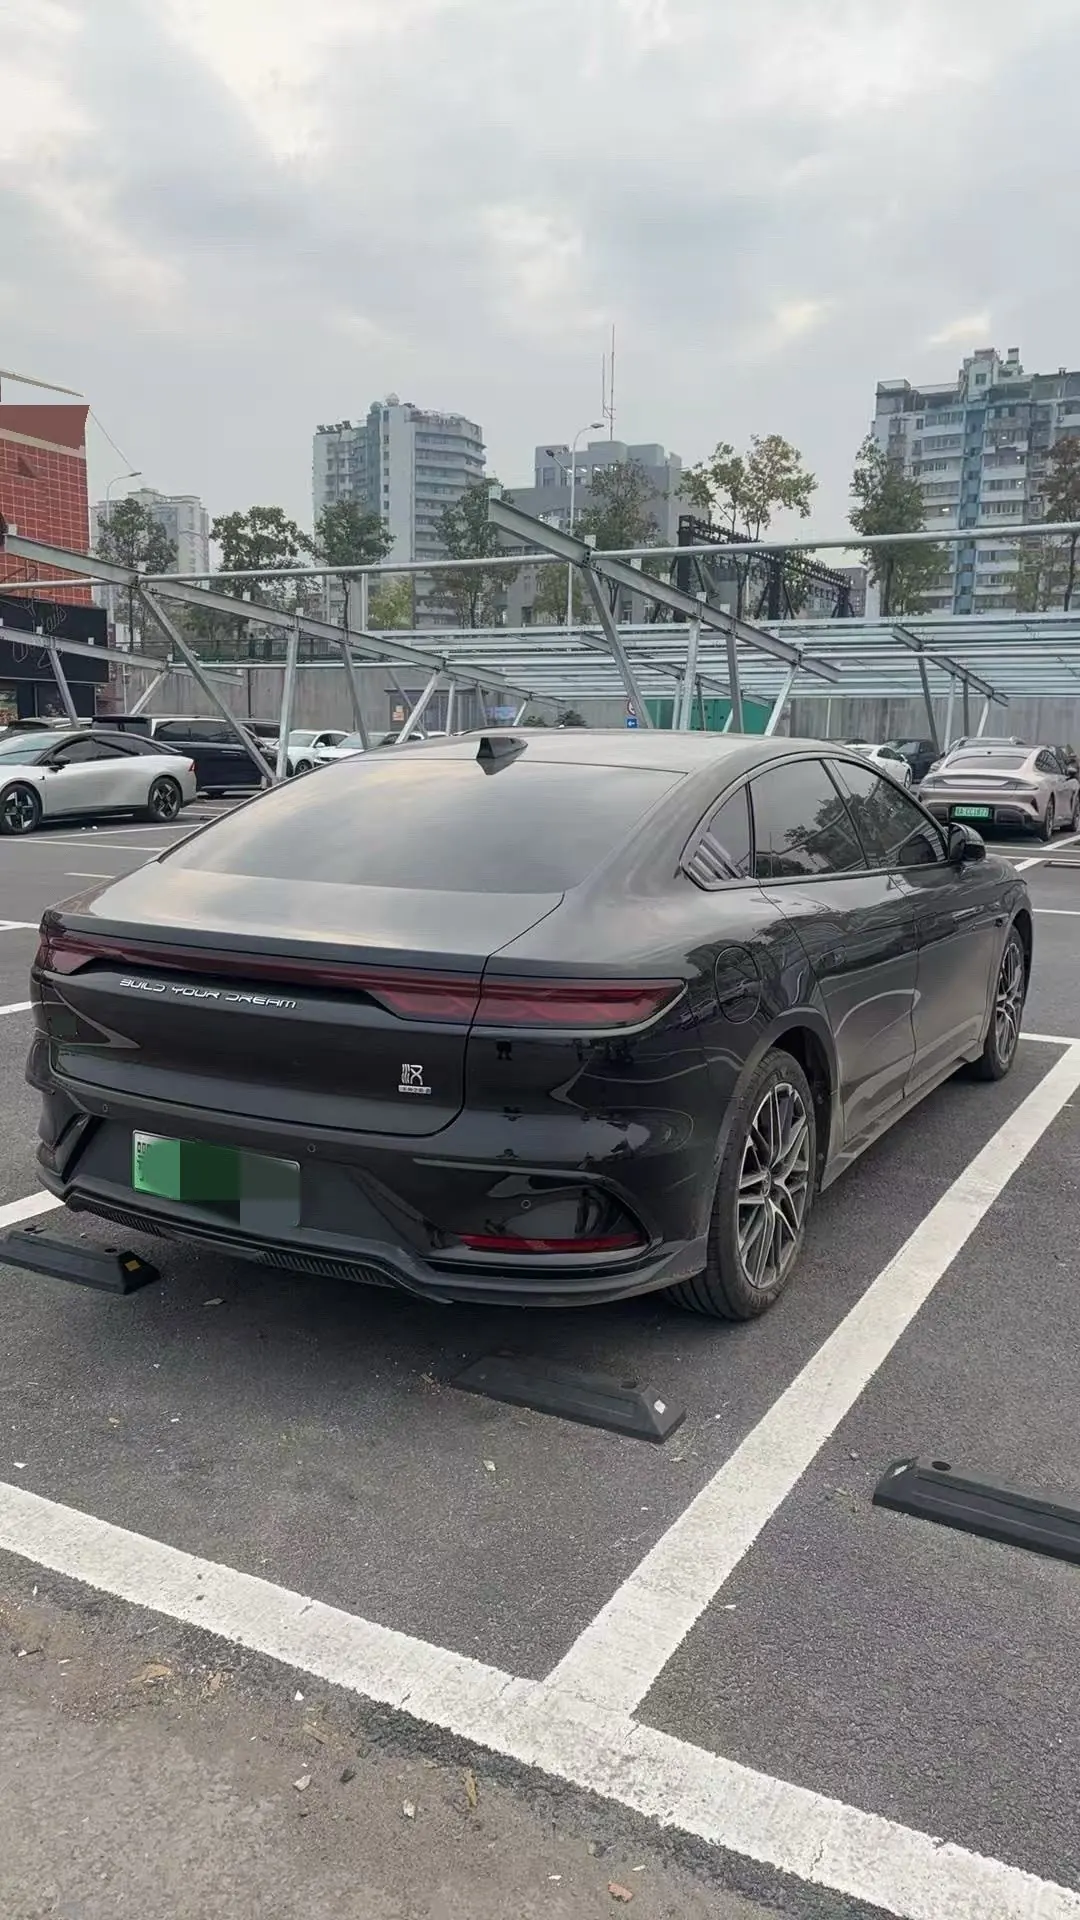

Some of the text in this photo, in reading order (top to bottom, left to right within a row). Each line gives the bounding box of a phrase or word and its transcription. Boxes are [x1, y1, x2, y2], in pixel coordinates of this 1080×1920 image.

[119, 978, 297, 1009] BUILD YOUR DREAM
